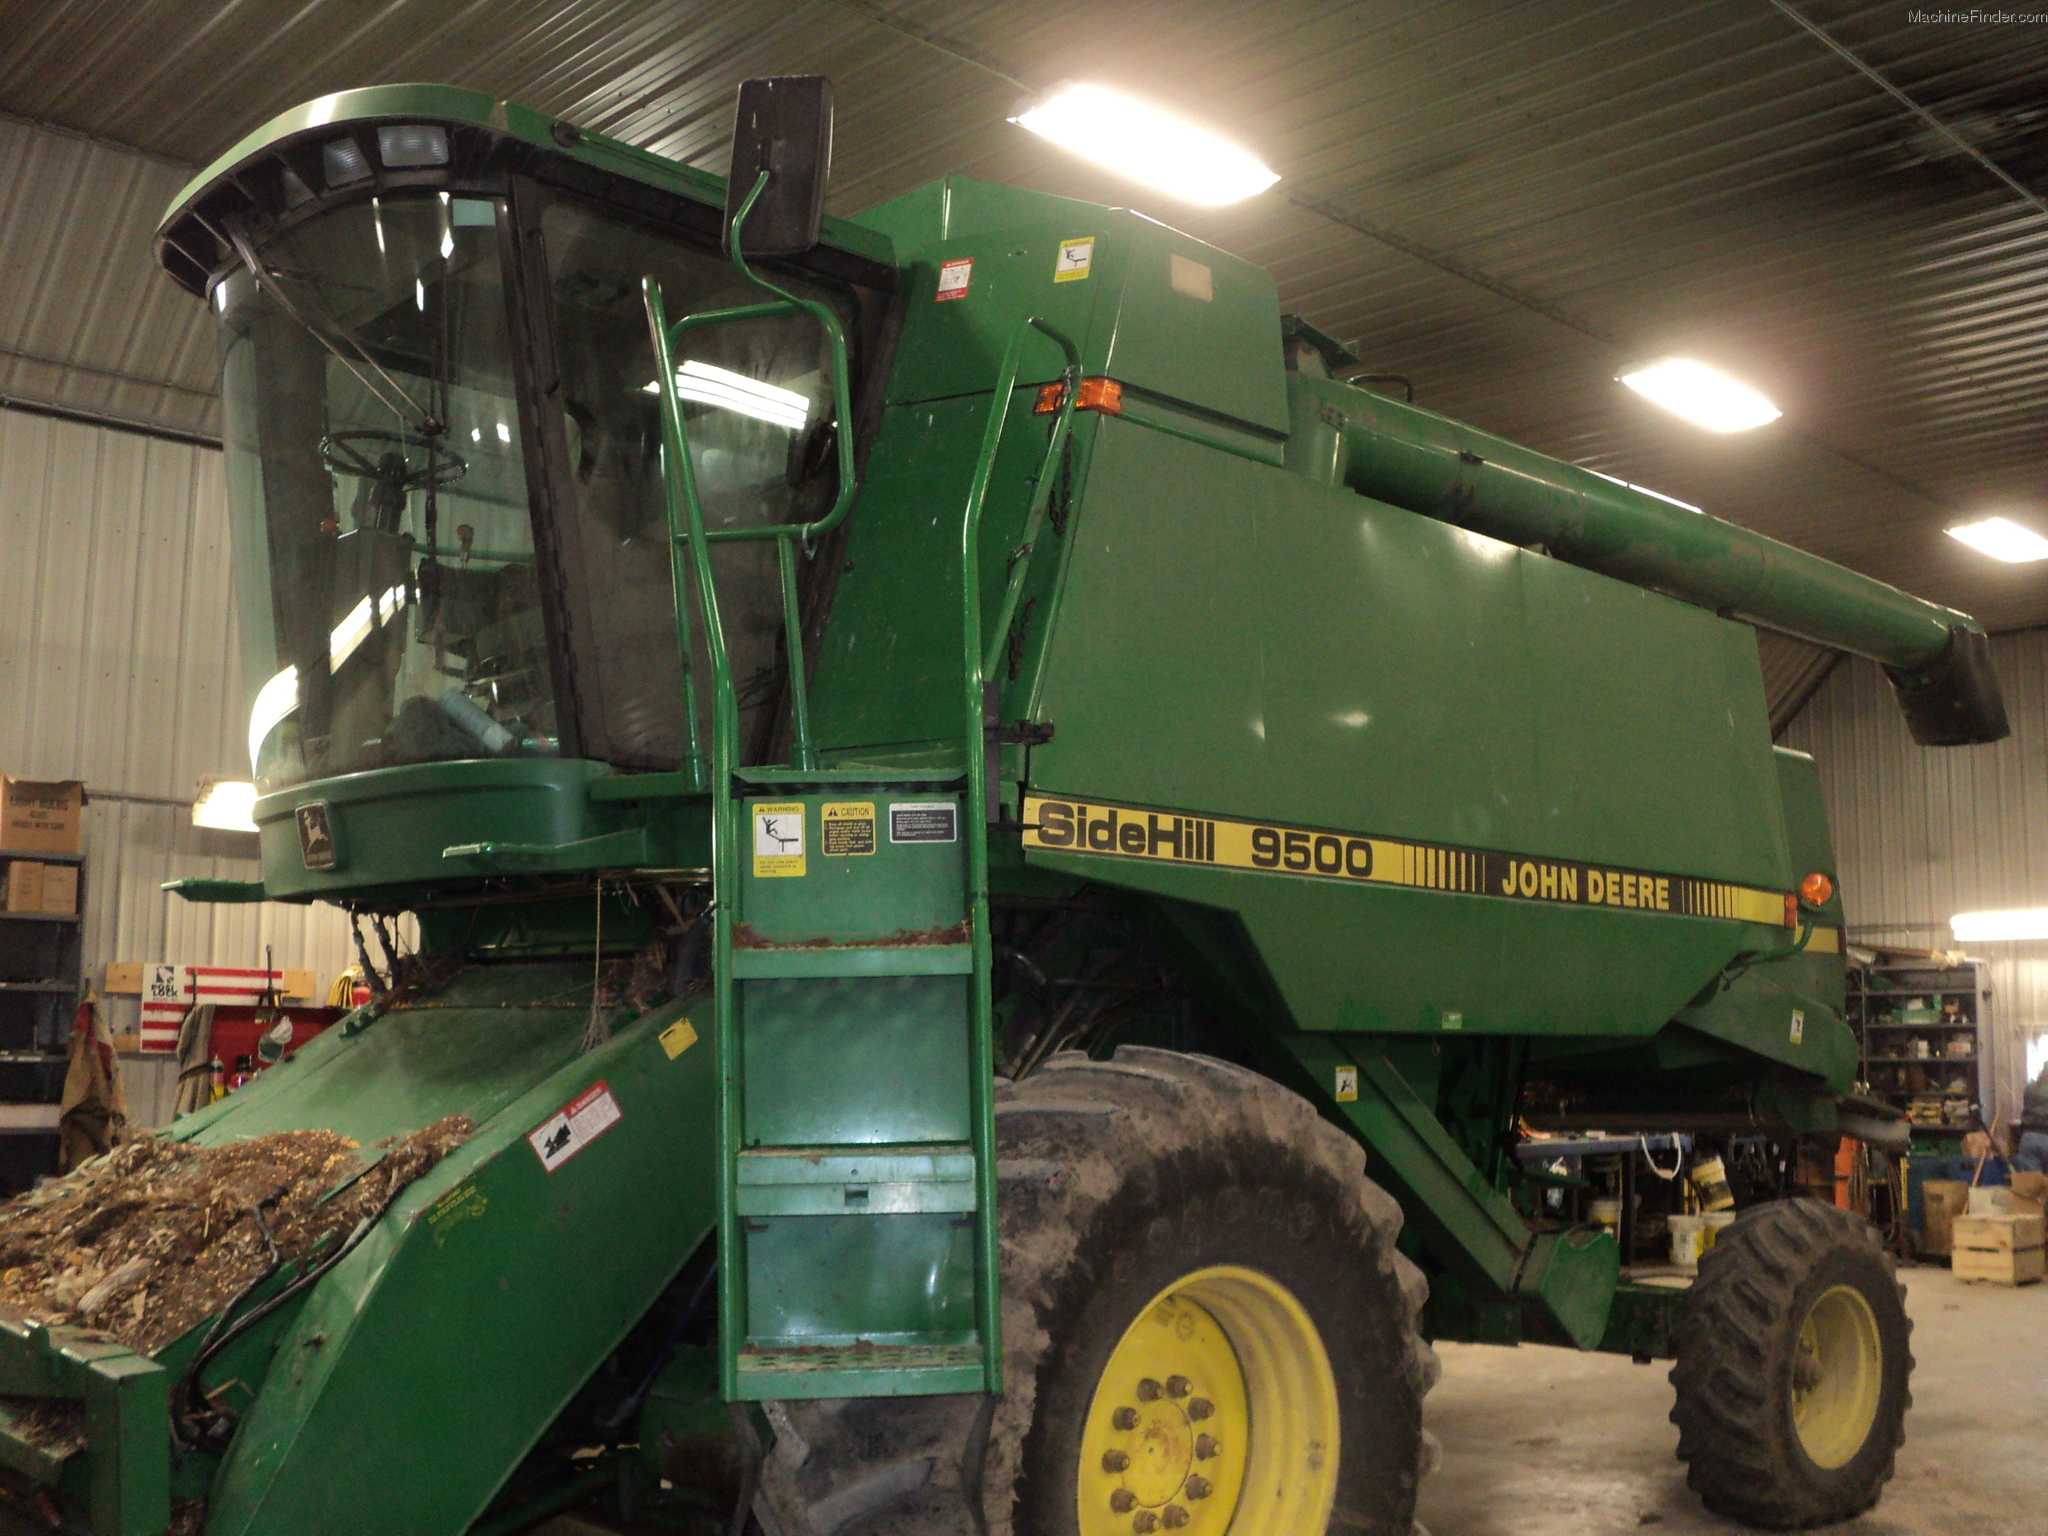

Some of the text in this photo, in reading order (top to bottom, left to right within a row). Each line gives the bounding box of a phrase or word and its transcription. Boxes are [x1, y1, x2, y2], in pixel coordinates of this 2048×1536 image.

[841, 807, 870, 816] CAUTION
[1037, 801, 1374, 878] SideHill 9500
[1502, 860, 1670, 911] JOHN DEERE
